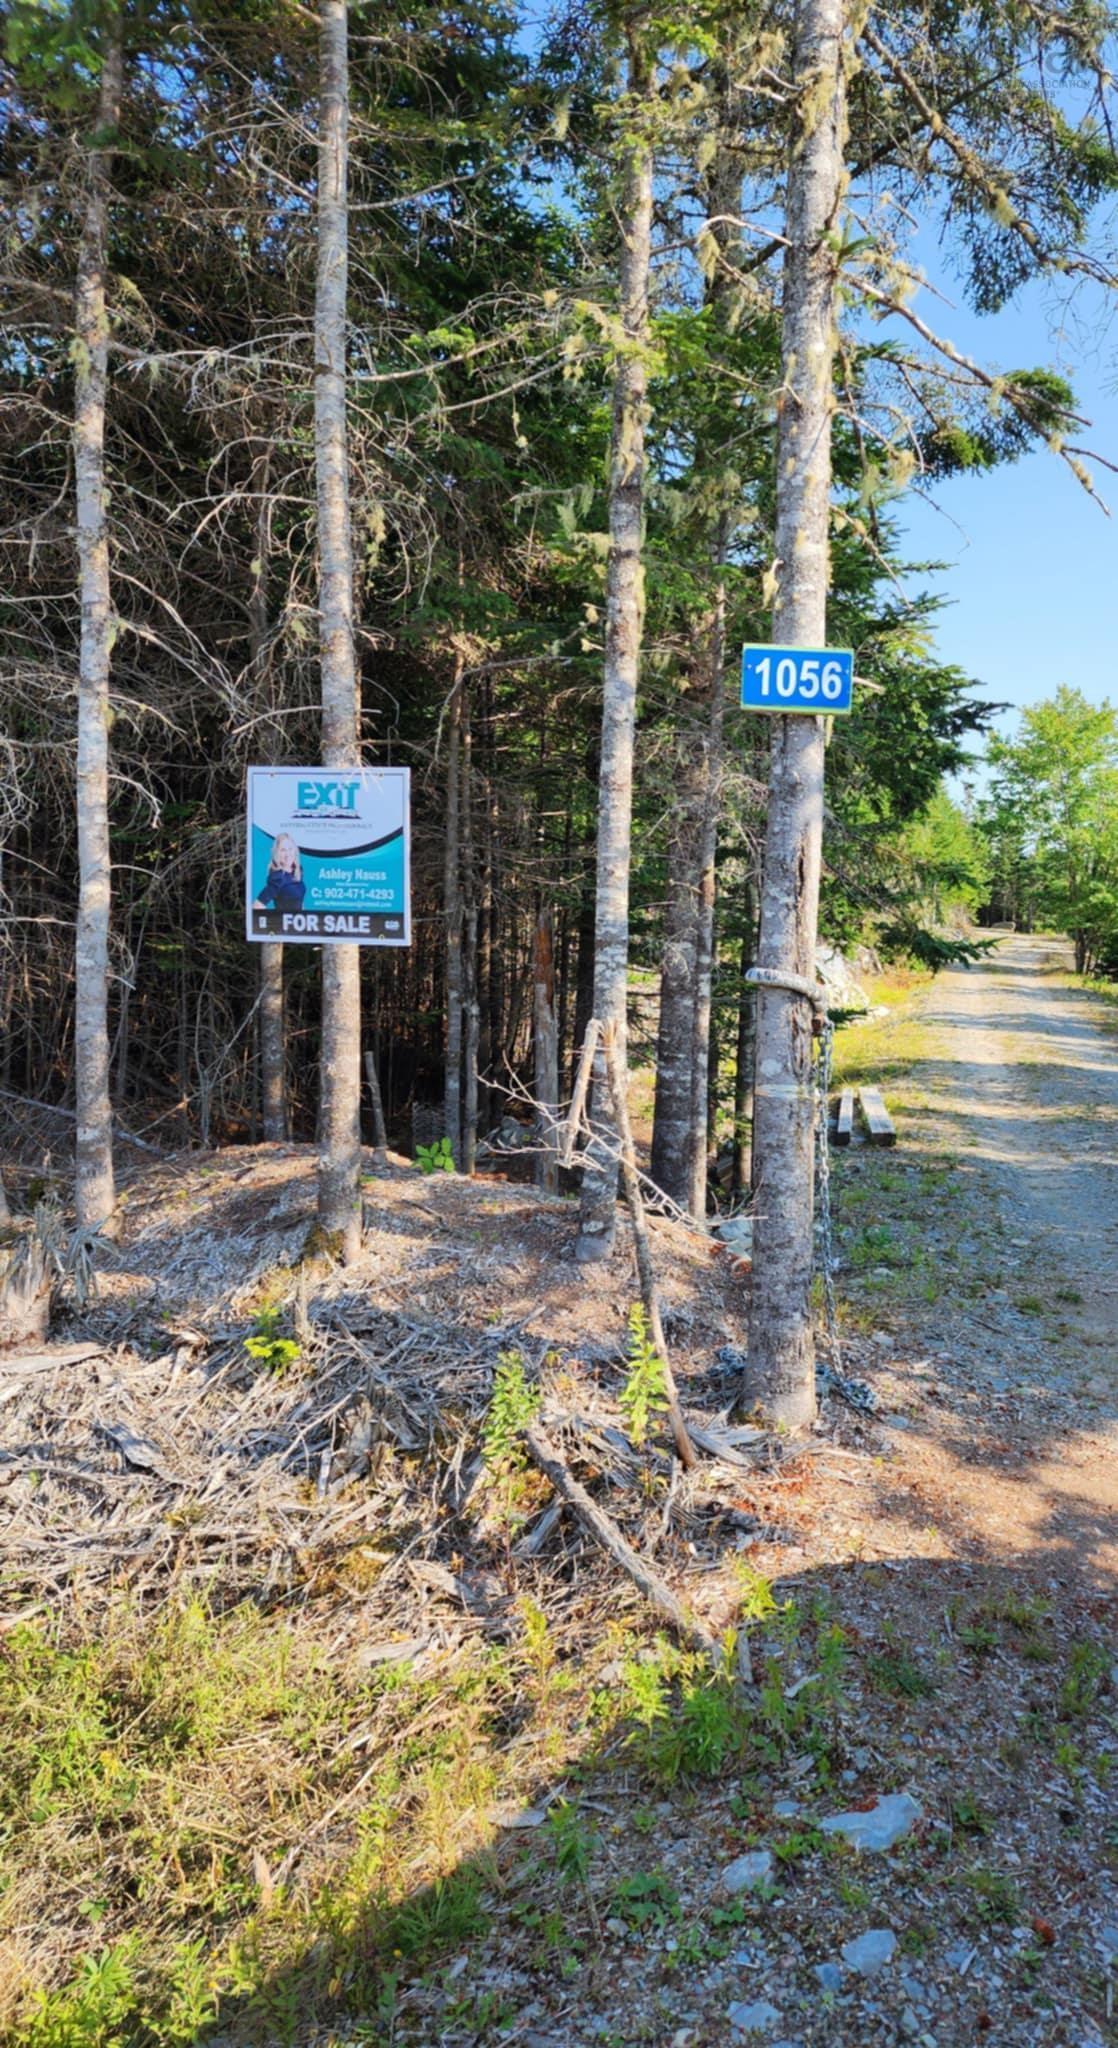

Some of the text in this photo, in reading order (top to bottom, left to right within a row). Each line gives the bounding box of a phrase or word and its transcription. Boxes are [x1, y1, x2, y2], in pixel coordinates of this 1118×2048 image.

[755, 657, 843, 700] 1056
[319, 868, 353, 882] Ashley
[311, 887, 322, 898] C:
[282, 914, 319, 932] FOR
[323, 915, 371, 934] SALE
